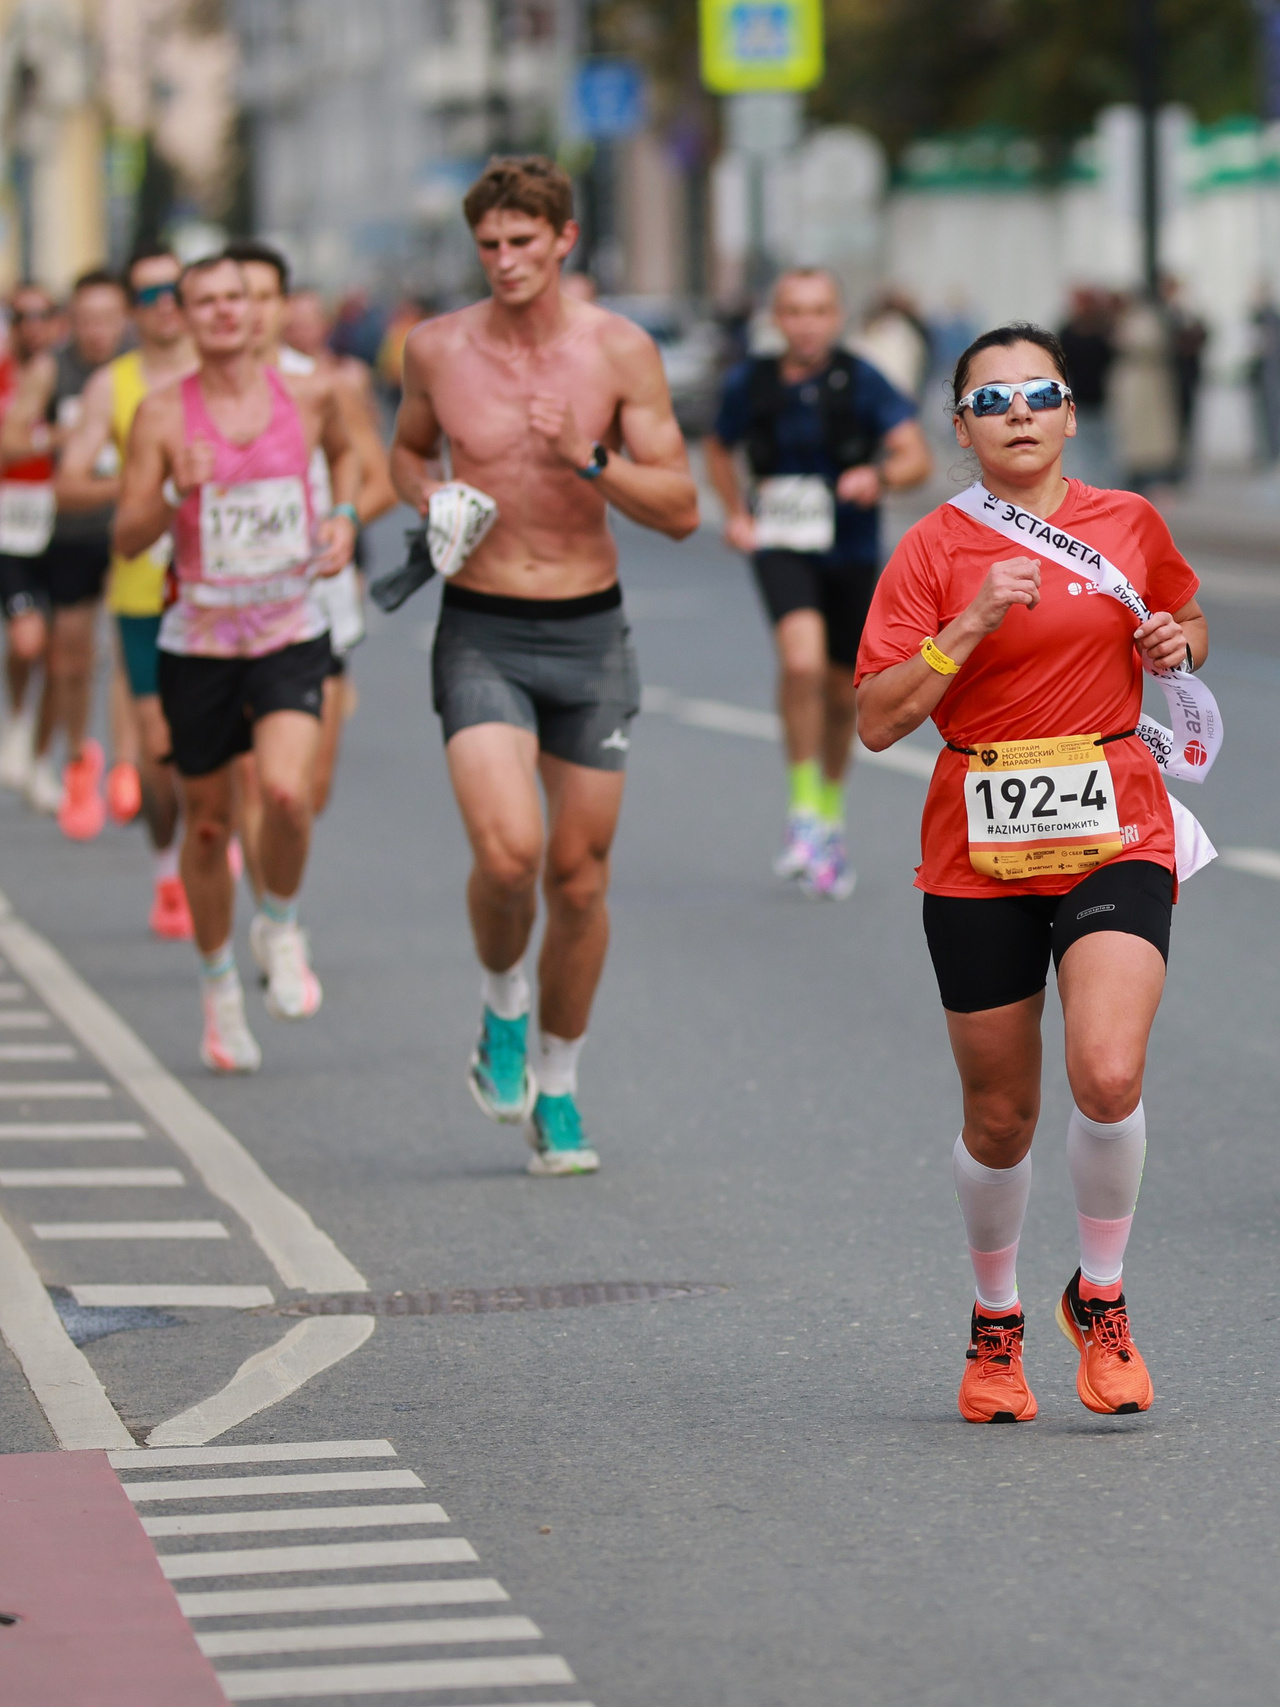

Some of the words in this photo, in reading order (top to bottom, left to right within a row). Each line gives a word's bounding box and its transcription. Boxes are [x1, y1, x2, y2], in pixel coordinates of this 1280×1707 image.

[1001, 504, 1101, 570] ЭСТАФЕТА
[1206, 709, 1215, 739] HOTELS
[1001, 745, 1040, 753] СБЕРПРАЙМ
[1002, 750, 1055, 760] МОСКОВСКИЙ
[1002, 758, 1042, 767] МАРАФОН
[975, 769, 1107, 820] 192-4
[987, 820, 1100, 835] #AZIMUTбегомжить
